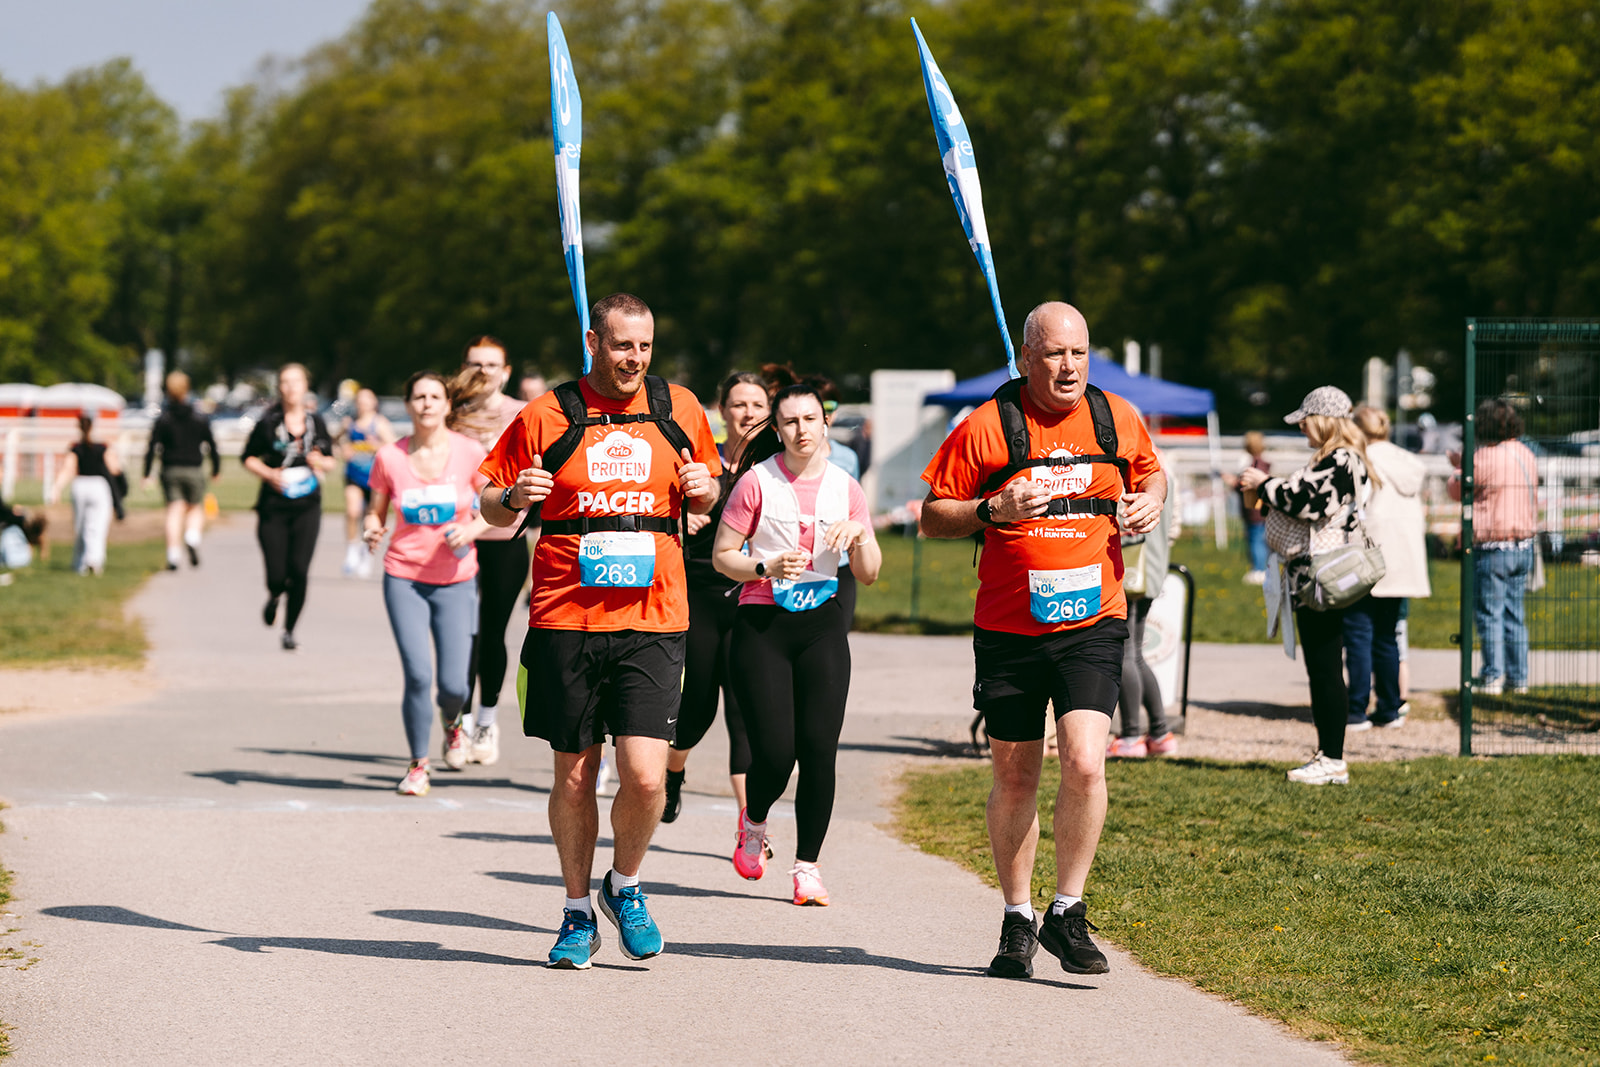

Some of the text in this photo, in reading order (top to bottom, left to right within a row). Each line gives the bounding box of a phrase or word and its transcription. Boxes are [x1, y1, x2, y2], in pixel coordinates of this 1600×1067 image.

[609, 447, 630, 456] Arla
[591, 462, 646, 477] PROTEIN
[578, 491, 655, 513] PACER
[583, 545, 604, 556] 10k
[594, 563, 637, 584] 263
[793, 589, 816, 608] 34
[1047, 597, 1088, 620] 266
